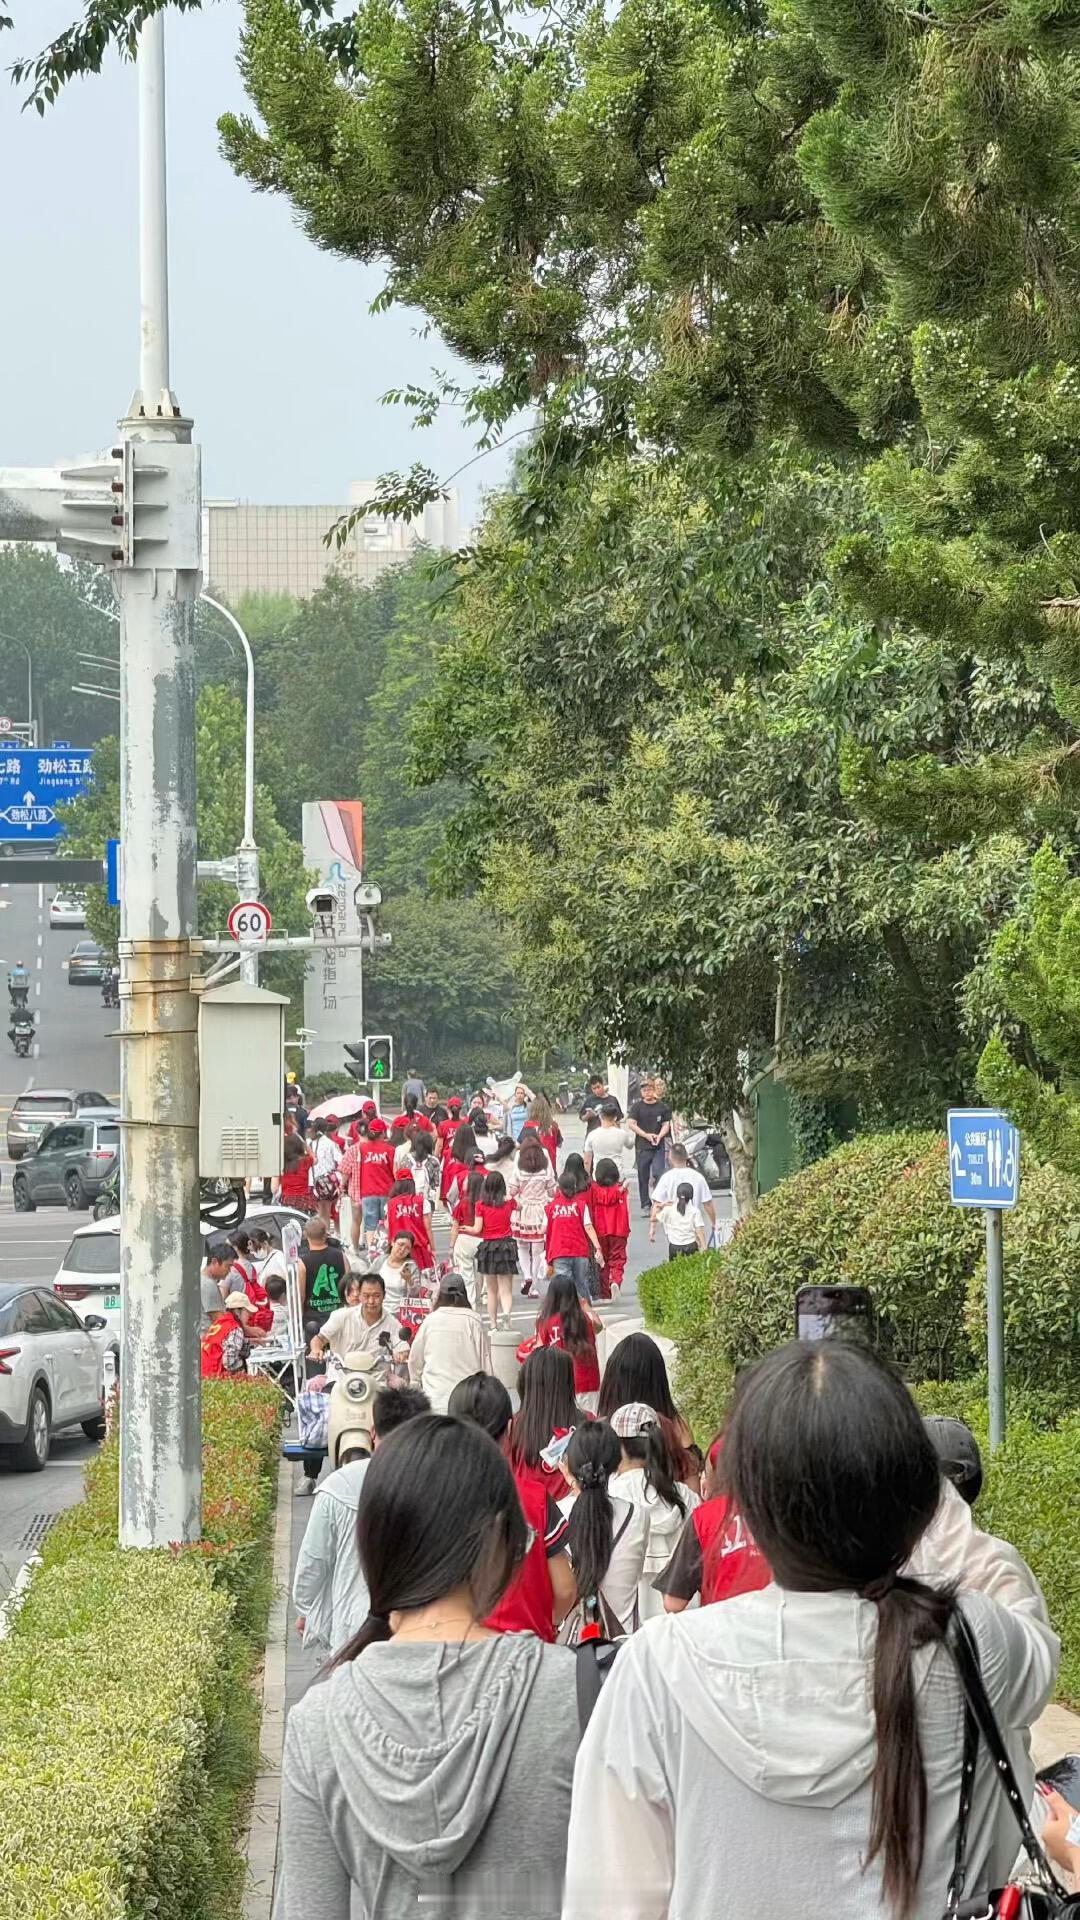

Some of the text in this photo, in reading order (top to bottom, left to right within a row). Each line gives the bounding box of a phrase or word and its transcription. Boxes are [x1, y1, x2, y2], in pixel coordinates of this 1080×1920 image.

[11, 808, 47, 821] 劲松八路
[238, 913, 261, 932] 60
